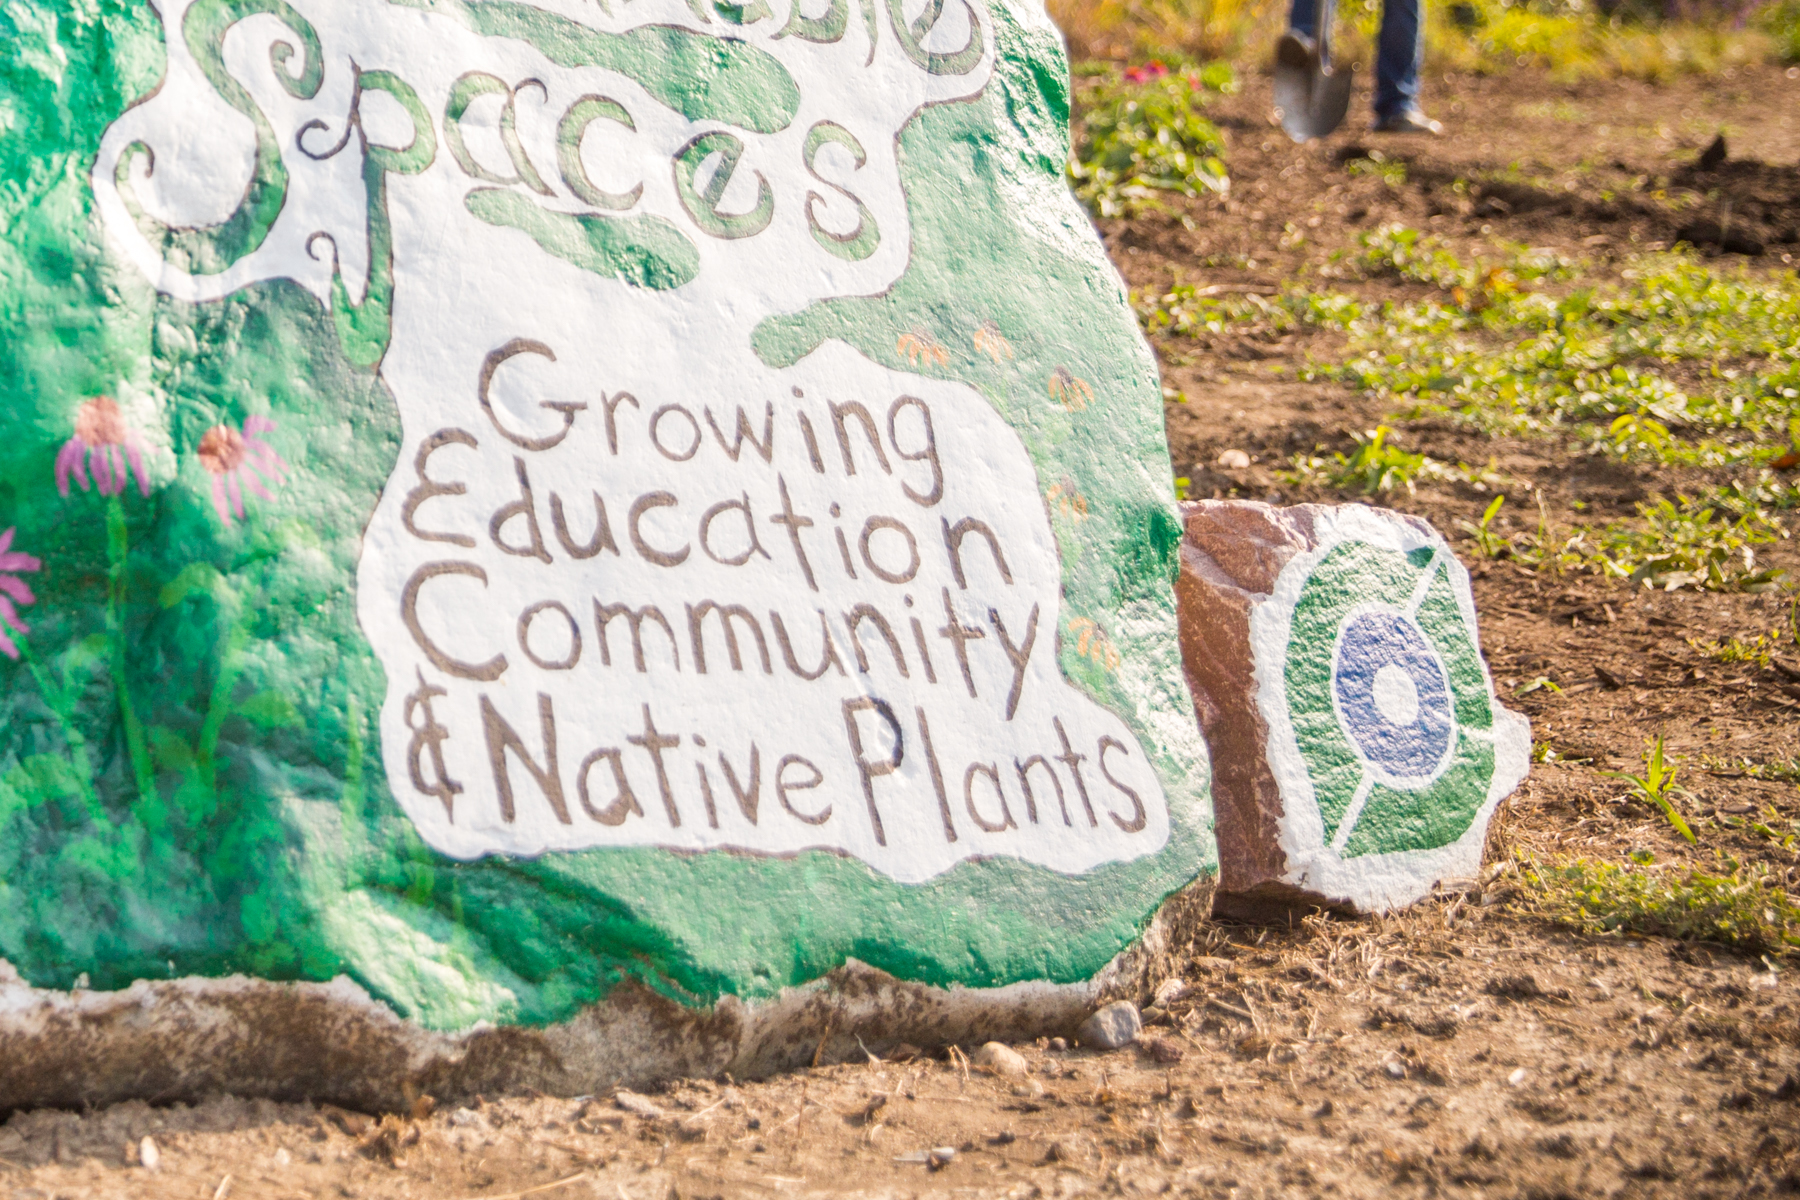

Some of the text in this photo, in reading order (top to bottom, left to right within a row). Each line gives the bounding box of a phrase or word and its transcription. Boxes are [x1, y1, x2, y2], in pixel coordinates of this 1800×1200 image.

[477, 337, 945, 508] Growing
[401, 427, 1013, 593] Education
[401, 560, 1040, 722] Community
[404, 666, 1147, 847] & Native Plants
